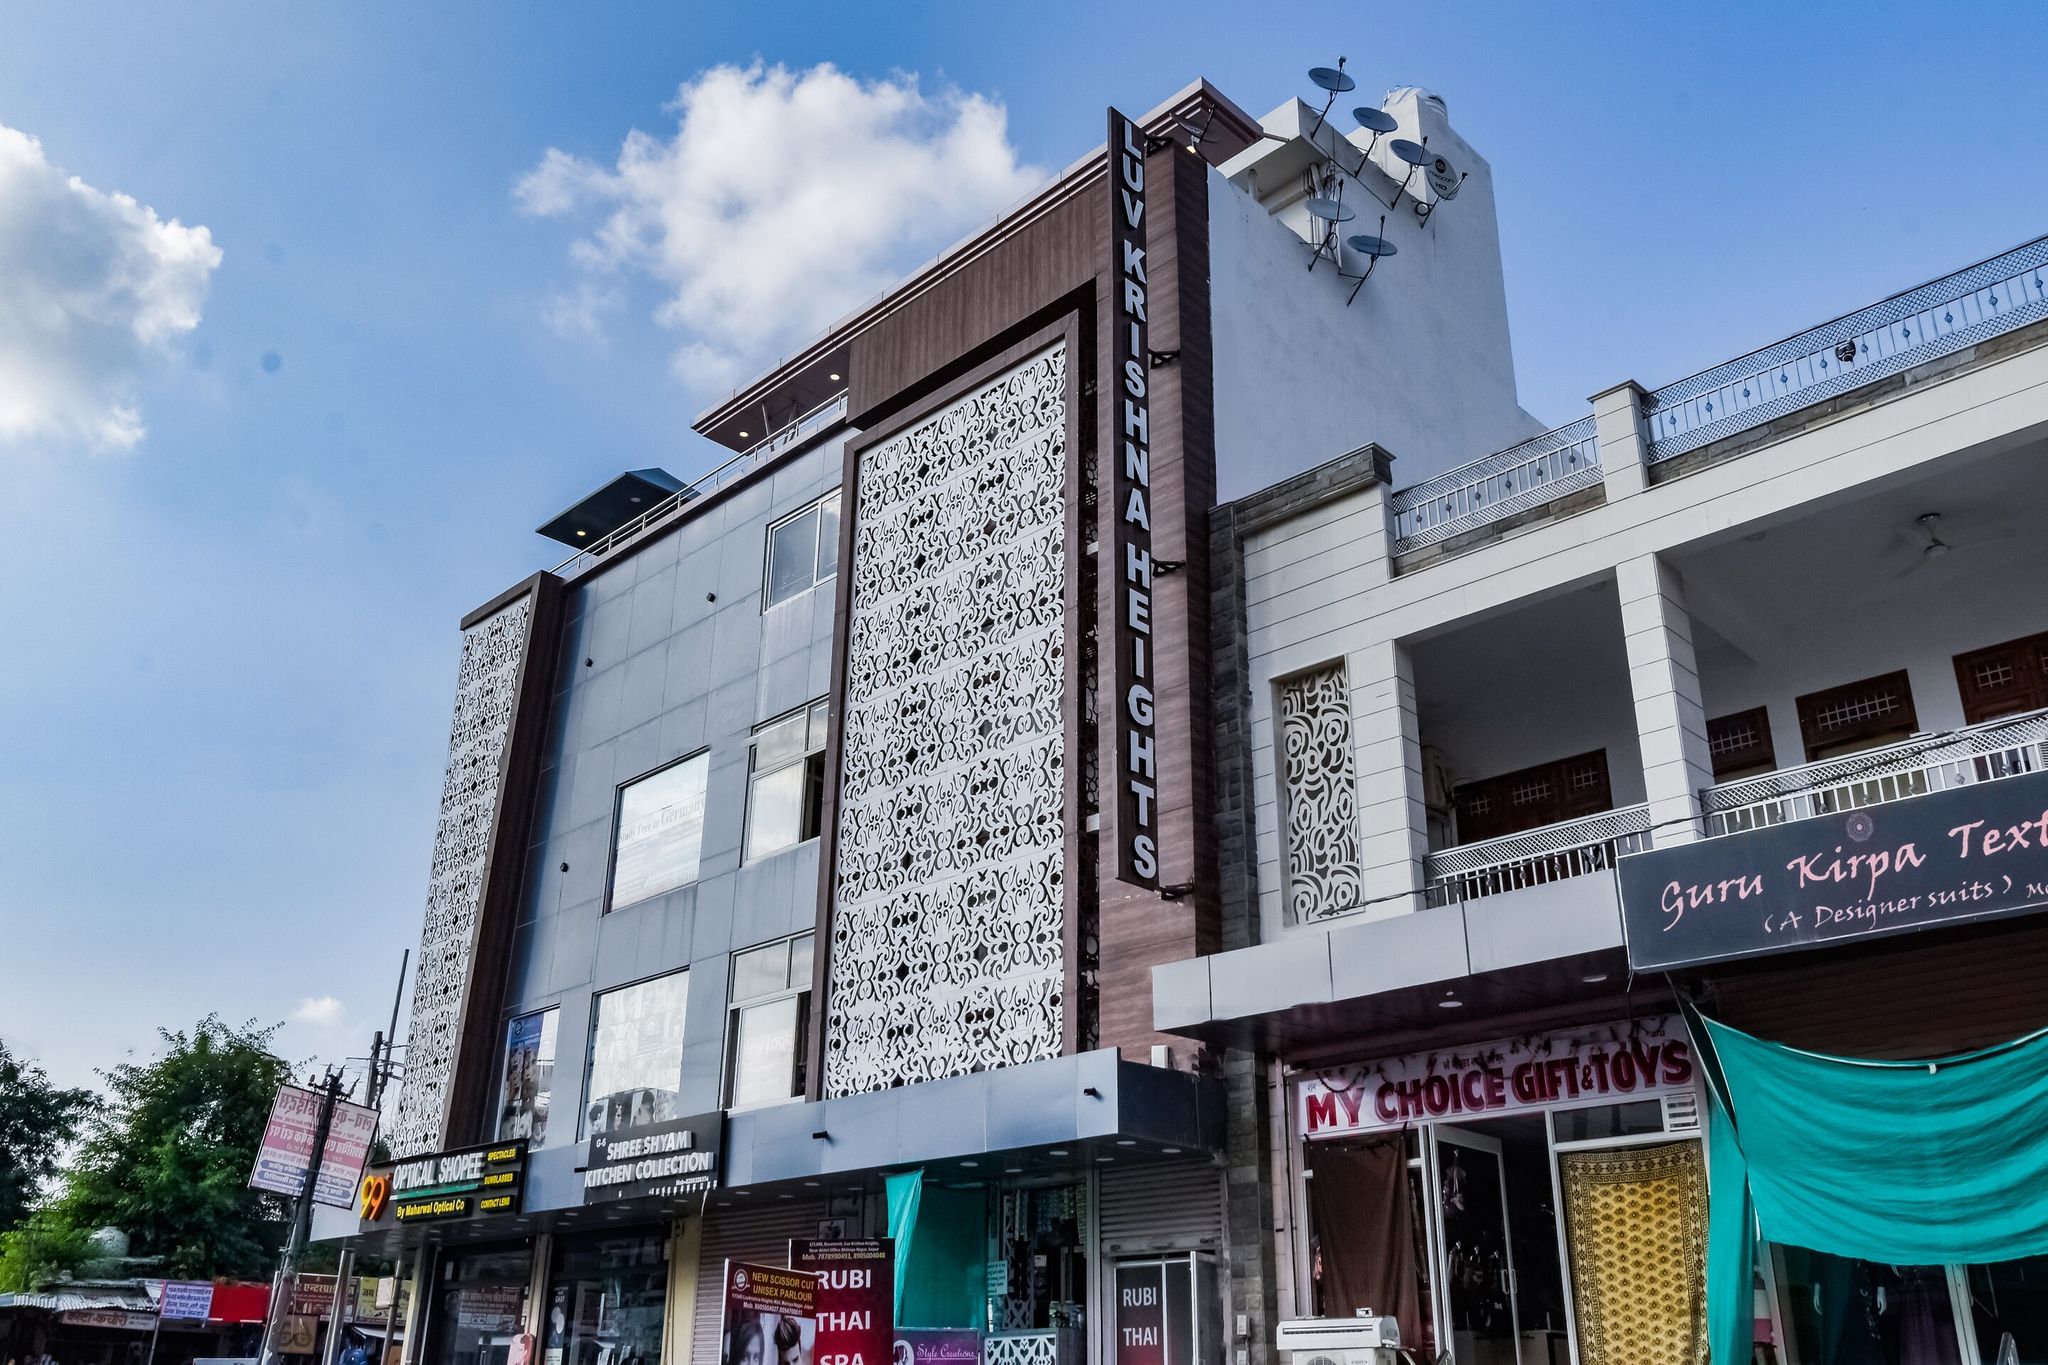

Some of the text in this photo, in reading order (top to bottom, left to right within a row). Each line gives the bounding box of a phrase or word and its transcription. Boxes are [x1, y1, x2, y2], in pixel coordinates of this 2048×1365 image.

[1121, 119, 1157, 879] LUV KRISHNA HEIGHTS
[1661, 872, 1764, 931] Guru
[1787, 842, 1926, 900] Kirpa
[1815, 894, 1921, 929] Designer
[1306, 1087, 1365, 1133] MY
[1374, 1067, 1506, 1123] CHOICE
[487, 1148, 516, 1161] SPECTACLES
[606, 1131, 692, 1160] SHREE SHYAM
[392, 1160, 435, 1190] OPTICAL
[438, 1152, 484, 1184] SHOPEE
[484, 1172, 513, 1185] SUNGLASSES
[584, 1152, 714, 1188] KITCHEN COLLECTION
[397, 1199, 465, 1219] By Maharwal Optical Co
[480, 1198, 499, 1210] CONTACT
[752, 1271, 815, 1290] NEW SCISSOR CUT
[814, 1269, 871, 1290] RUBI
[753, 1284, 813, 1301] UNISEX PARLOUR
[1123, 1287, 1157, 1307] RUBI
[816, 1310, 871, 1332] THAI
[1123, 1327, 1158, 1346] THAI
[916, 1343, 975, 1362] Style Creations
